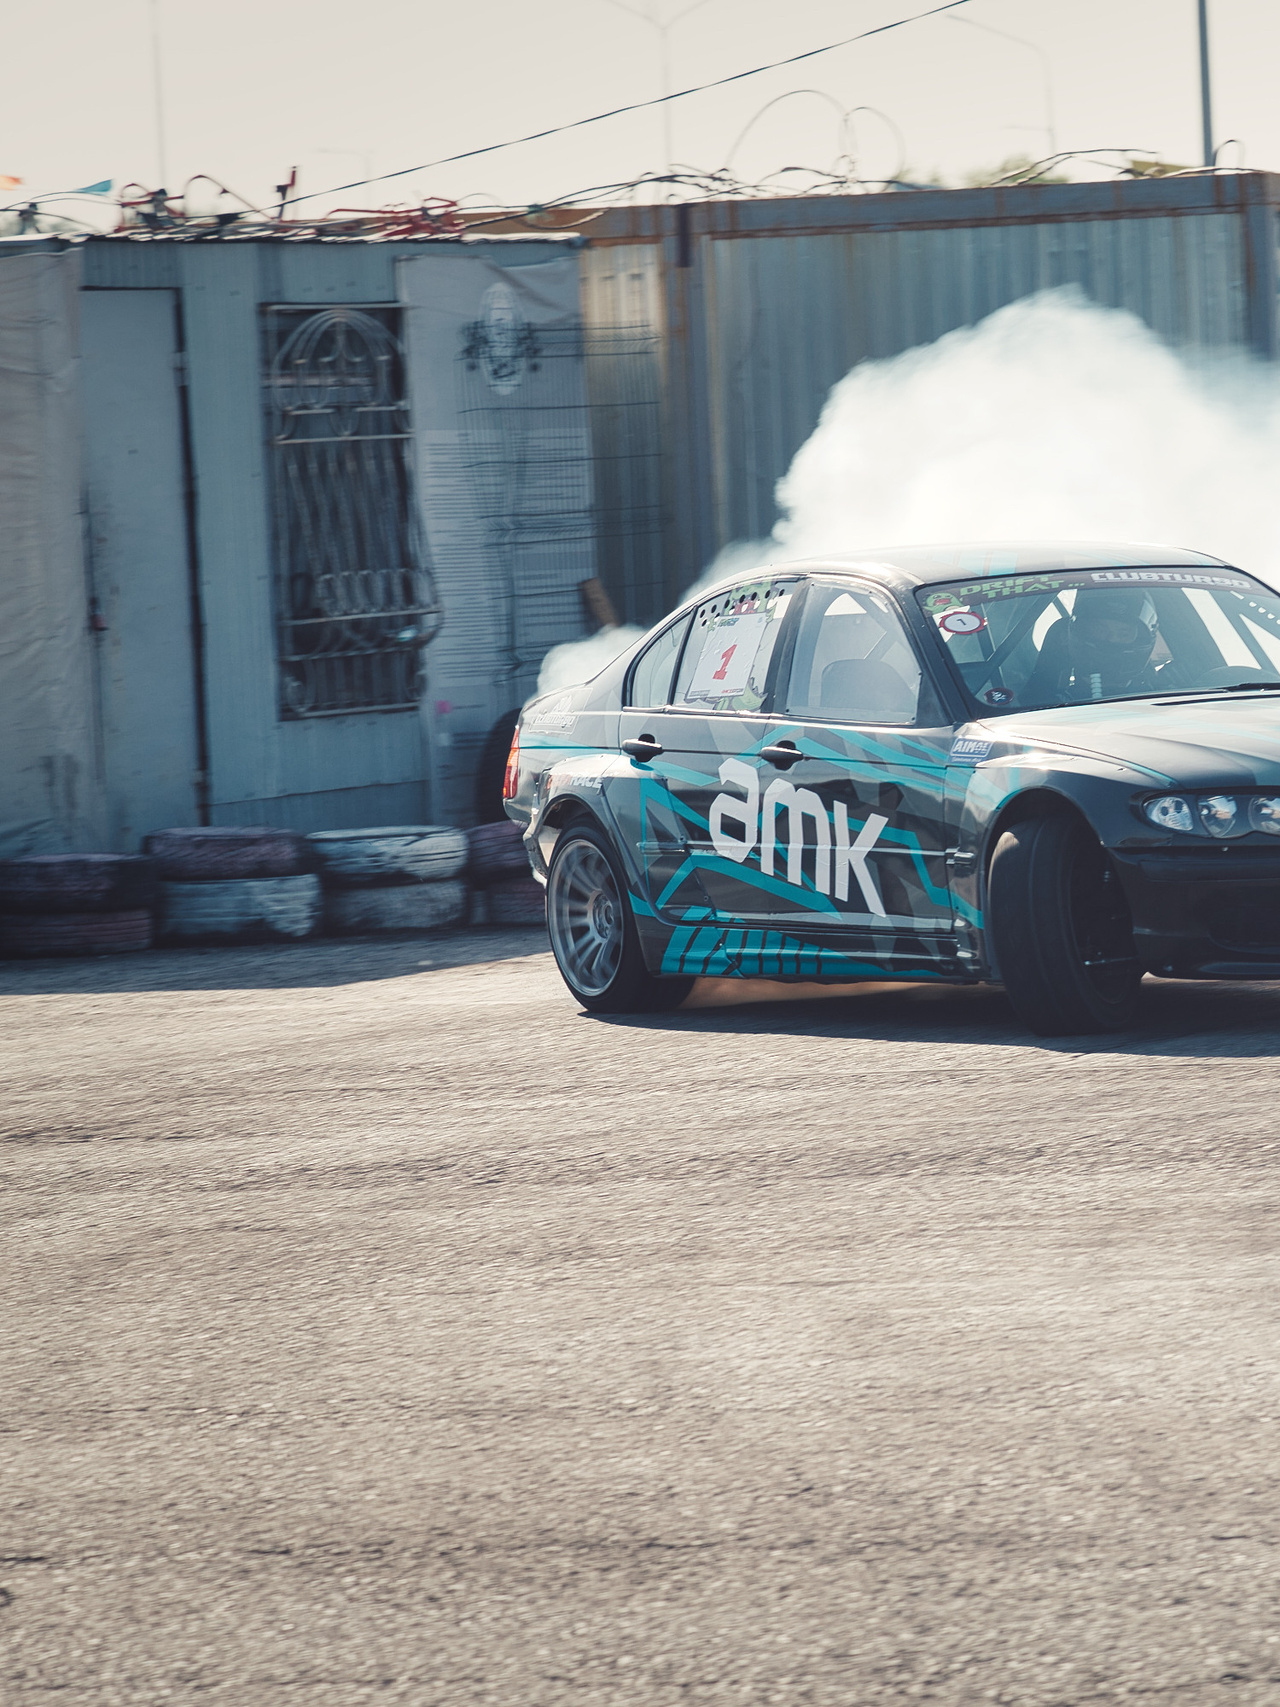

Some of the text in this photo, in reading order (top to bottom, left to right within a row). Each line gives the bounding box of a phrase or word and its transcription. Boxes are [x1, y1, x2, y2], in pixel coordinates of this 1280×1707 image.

[960, 574, 1054, 596] DRIFT
[1091, 572, 1251, 588] CLUBTURBO
[712, 644, 737, 680] 1
